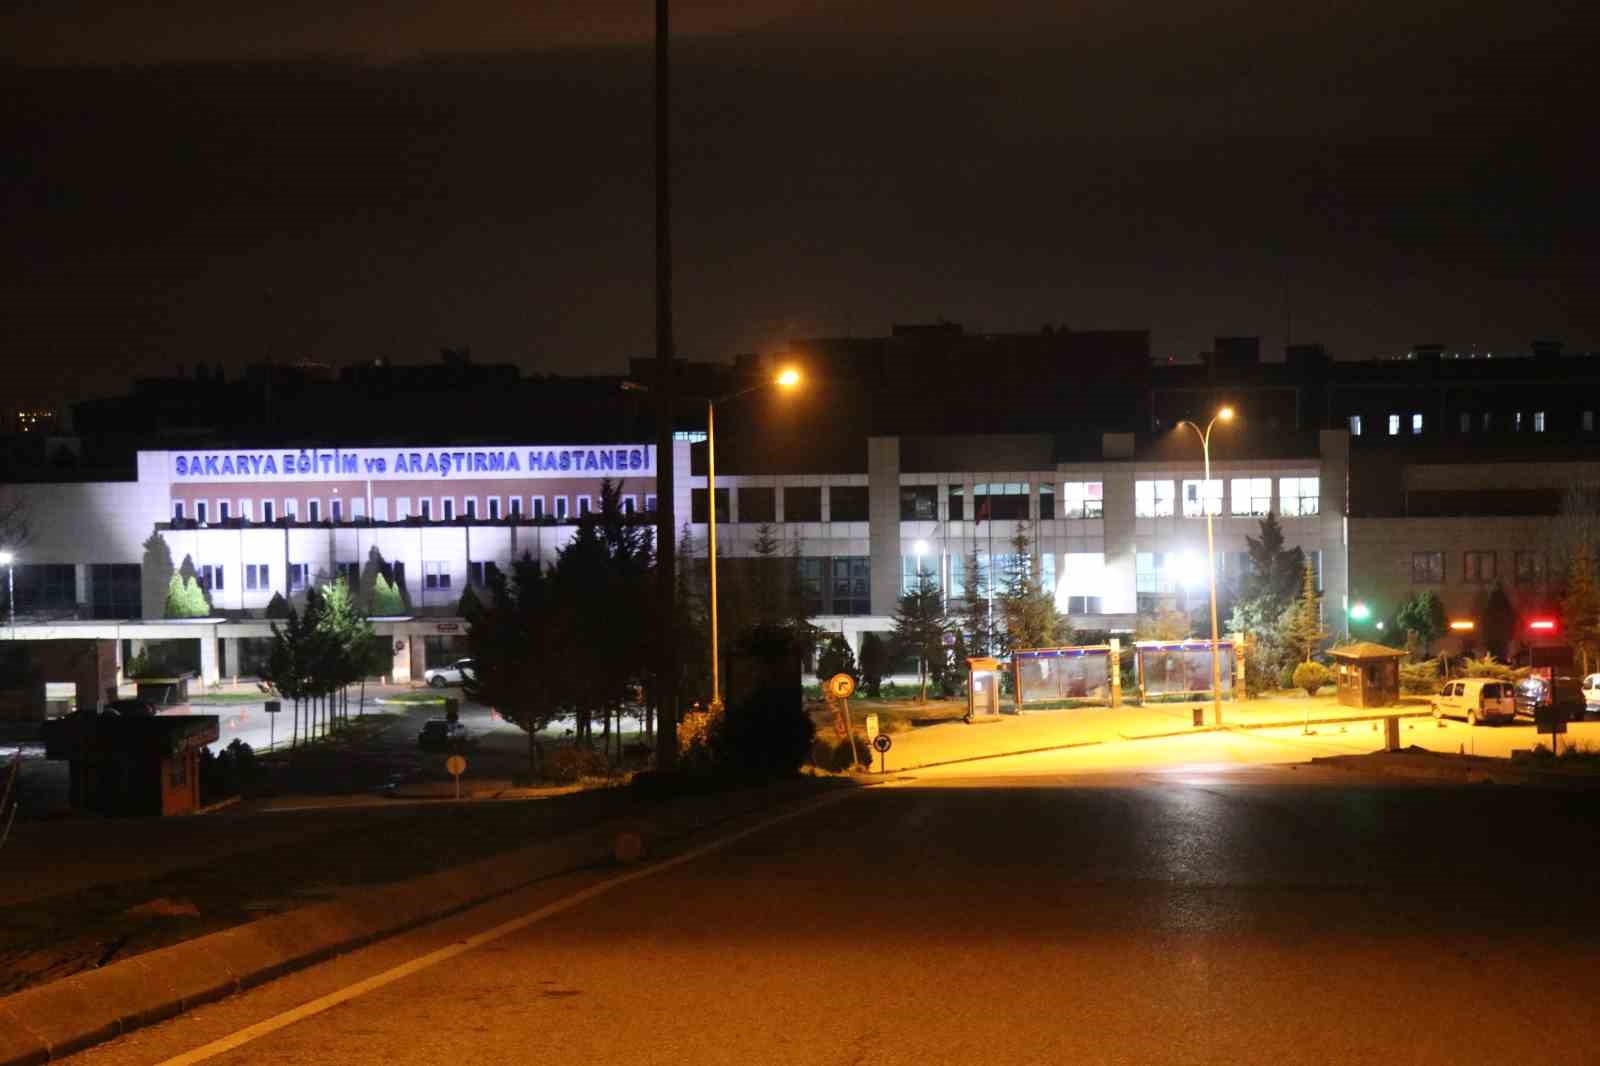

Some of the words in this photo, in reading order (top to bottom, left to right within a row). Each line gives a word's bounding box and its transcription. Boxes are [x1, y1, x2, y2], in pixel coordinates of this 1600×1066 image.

[176, 455, 278, 476] SAKARYA
[283, 449, 358, 473] EĞİTİM
[364, 458, 387, 473] ve
[394, 452, 520, 476] ARAŞTIRMA
[529, 445, 650, 471] HASTANESİ
